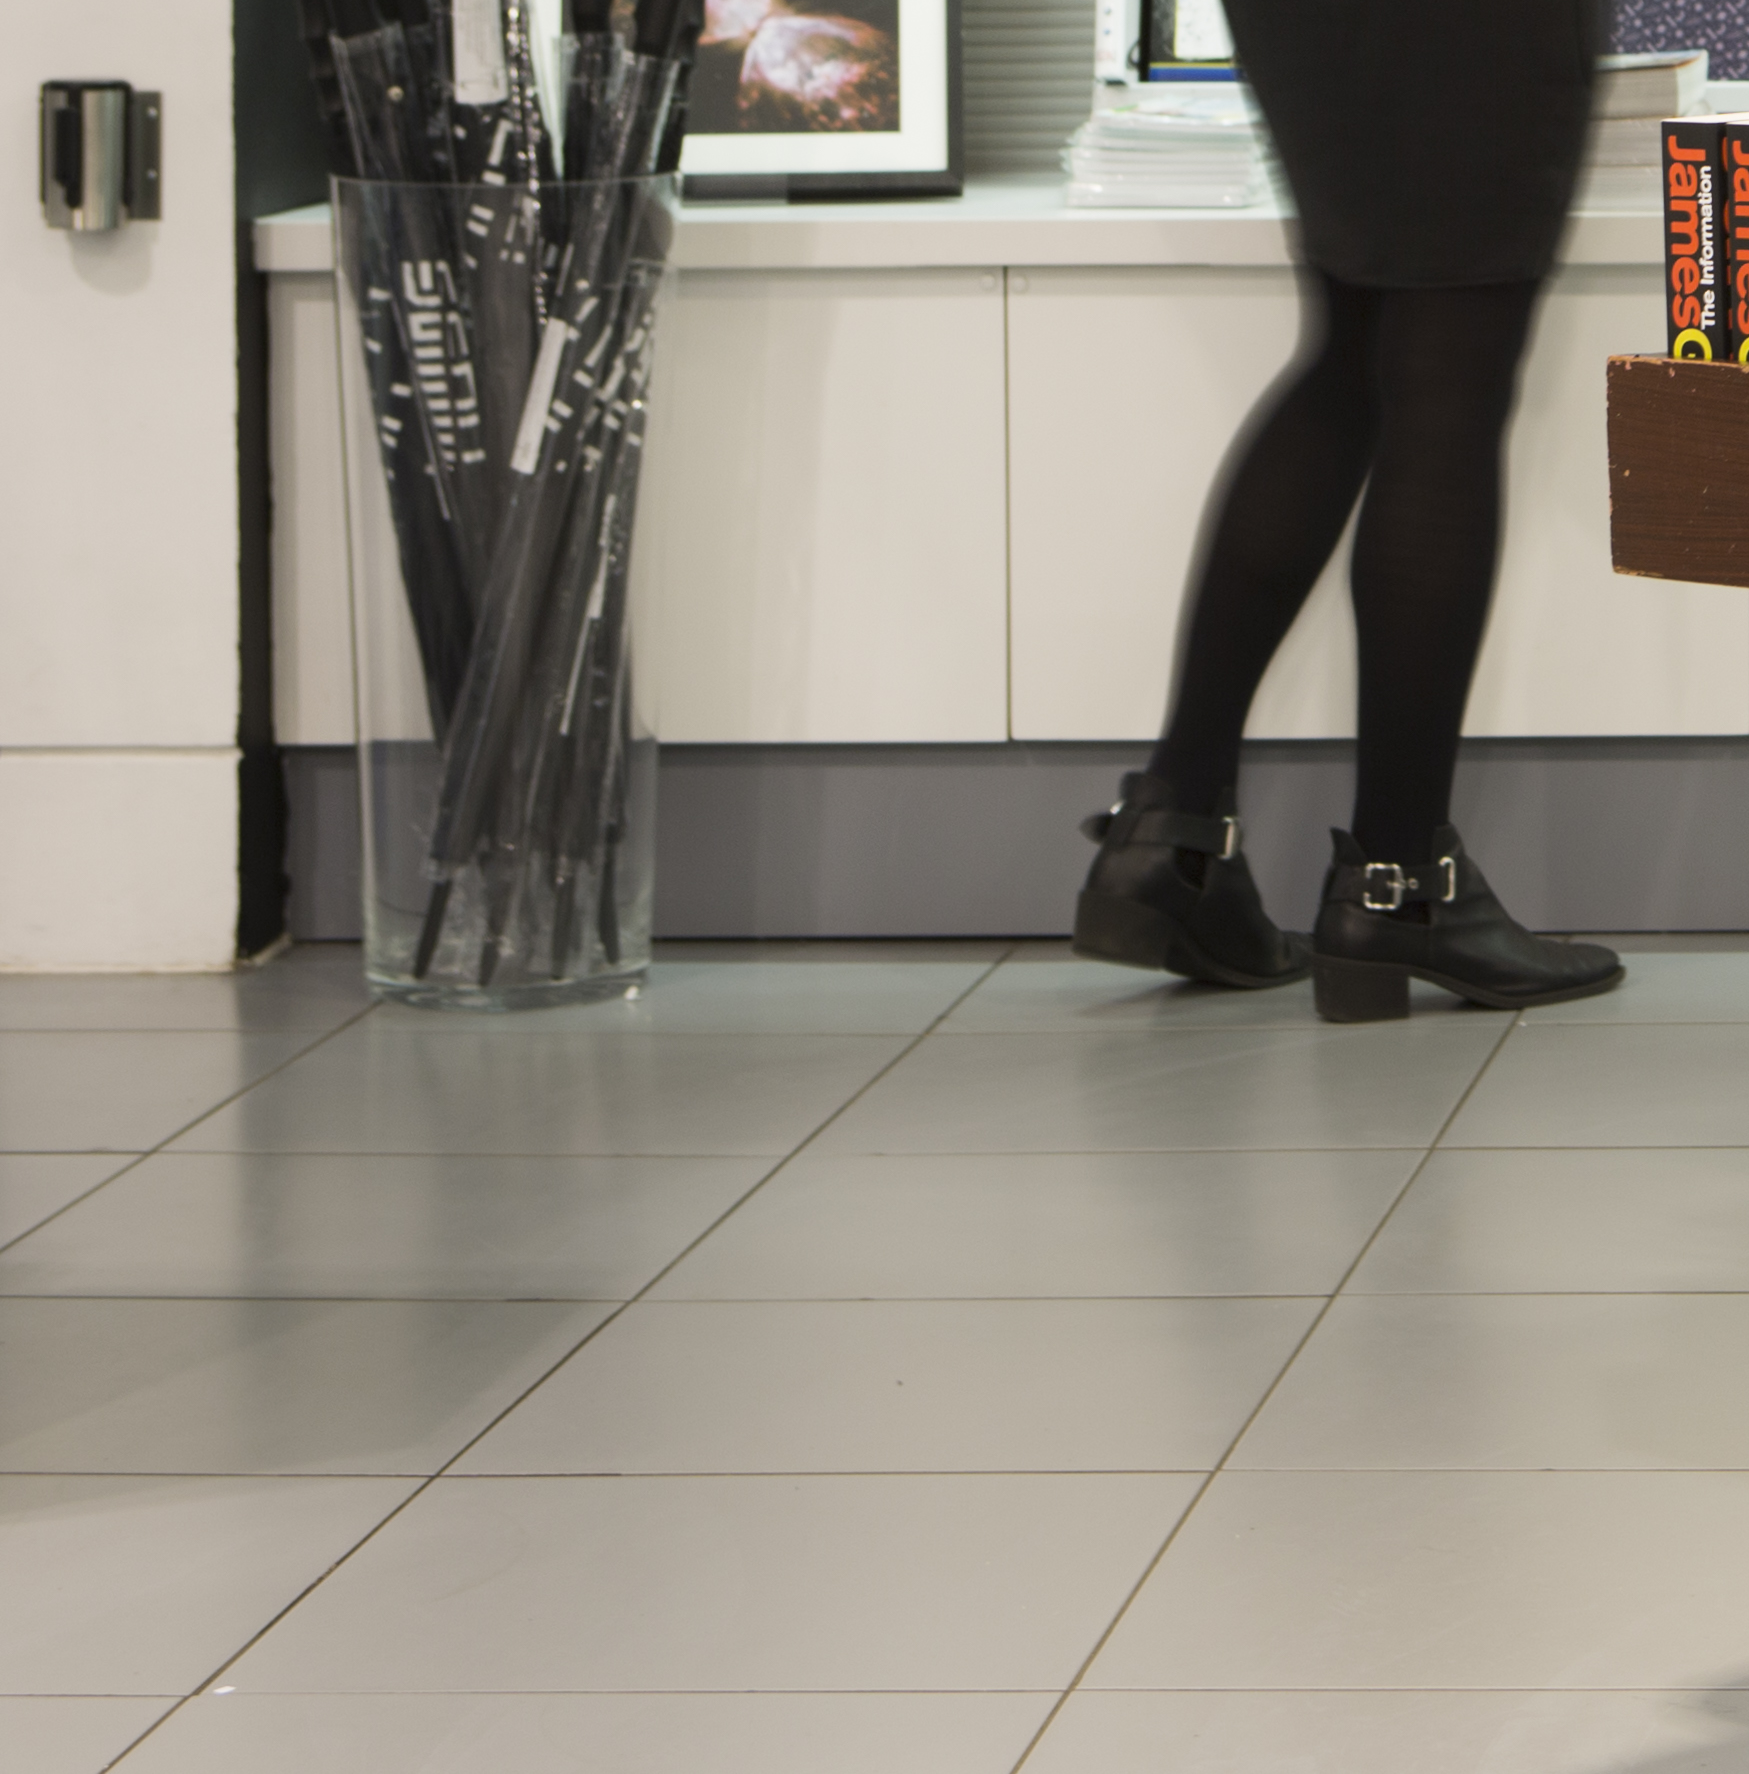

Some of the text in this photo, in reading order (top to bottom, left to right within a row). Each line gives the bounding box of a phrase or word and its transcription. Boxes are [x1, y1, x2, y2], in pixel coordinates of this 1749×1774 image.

[1667, 134, 1706, 330] James
[1698, 164, 1716, 331] The Information
